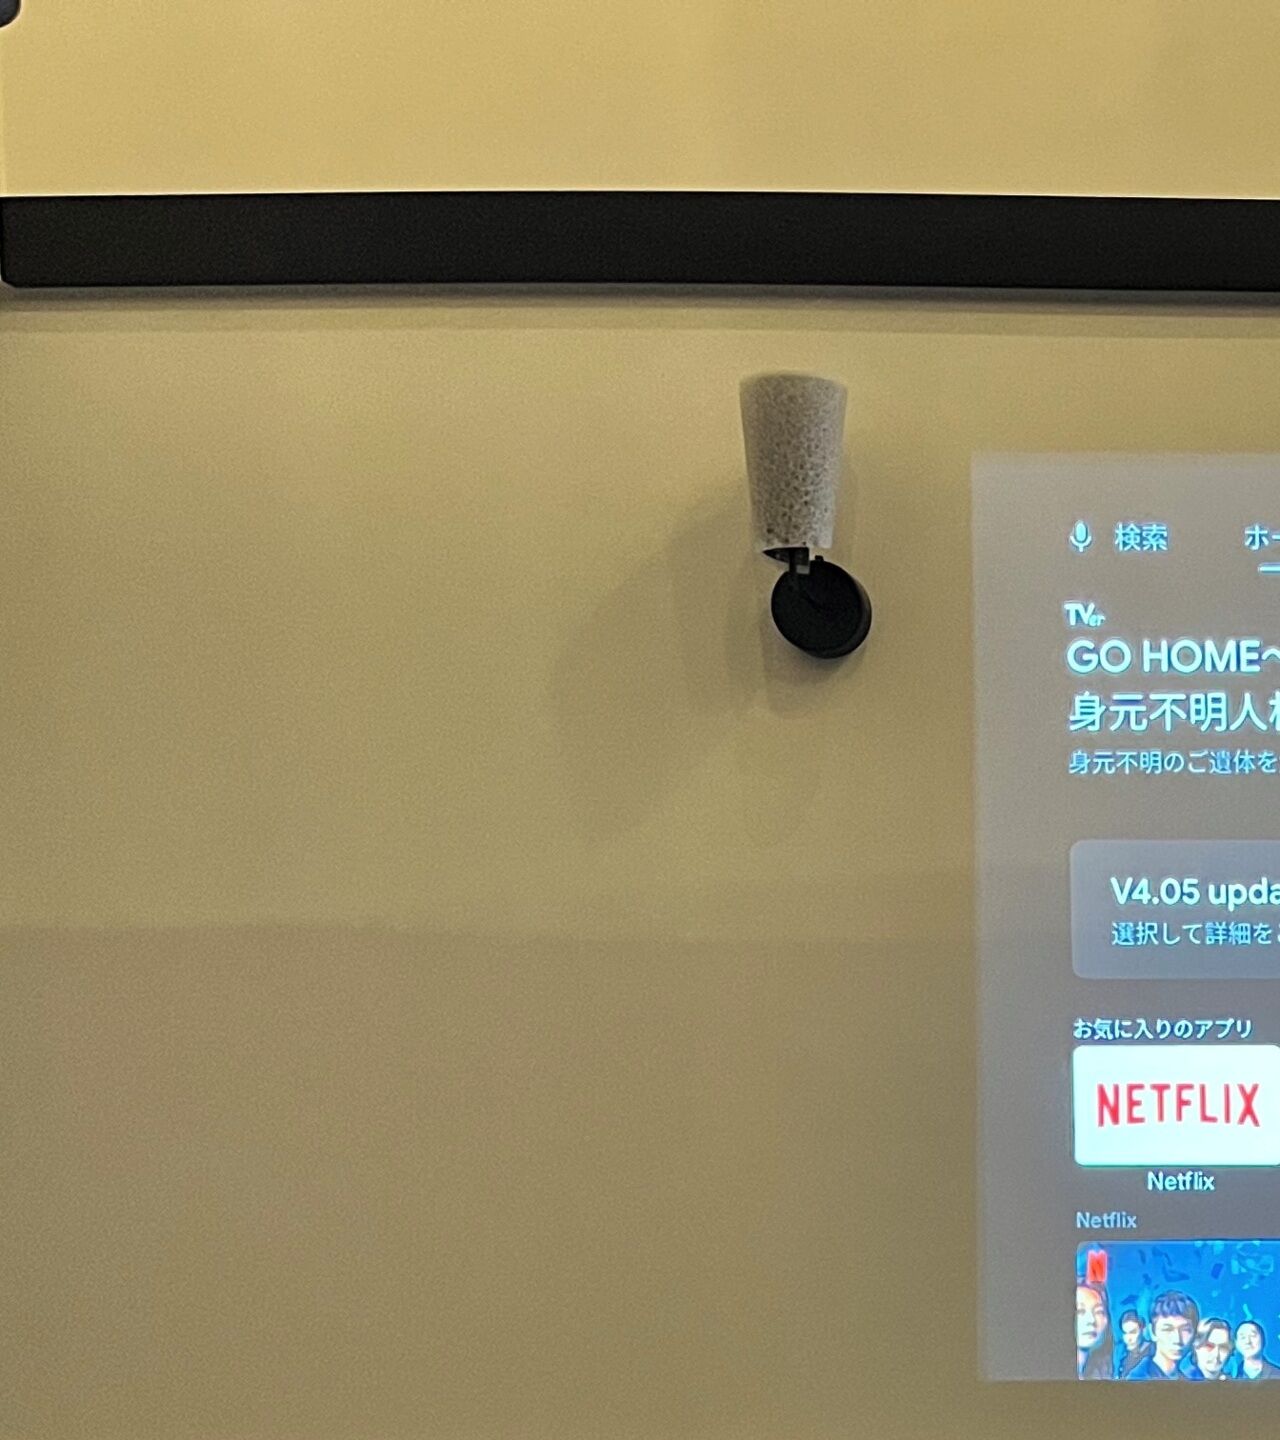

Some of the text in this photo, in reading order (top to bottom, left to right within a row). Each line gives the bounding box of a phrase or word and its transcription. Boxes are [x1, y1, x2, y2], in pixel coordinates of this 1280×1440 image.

[1114, 523, 1168, 551] 検索
[1063, 602, 1106, 627] TVer
[1066, 639, 1132, 674] GO
[1110, 877, 1200, 905] V4.05
[1073, 1018, 1252, 1040] お気に入りのアプリ
[1096, 1083, 1260, 1128] NETFLIX
[1147, 1171, 1215, 1191] Netflix
[1076, 1211, 1137, 1229] Netflix
